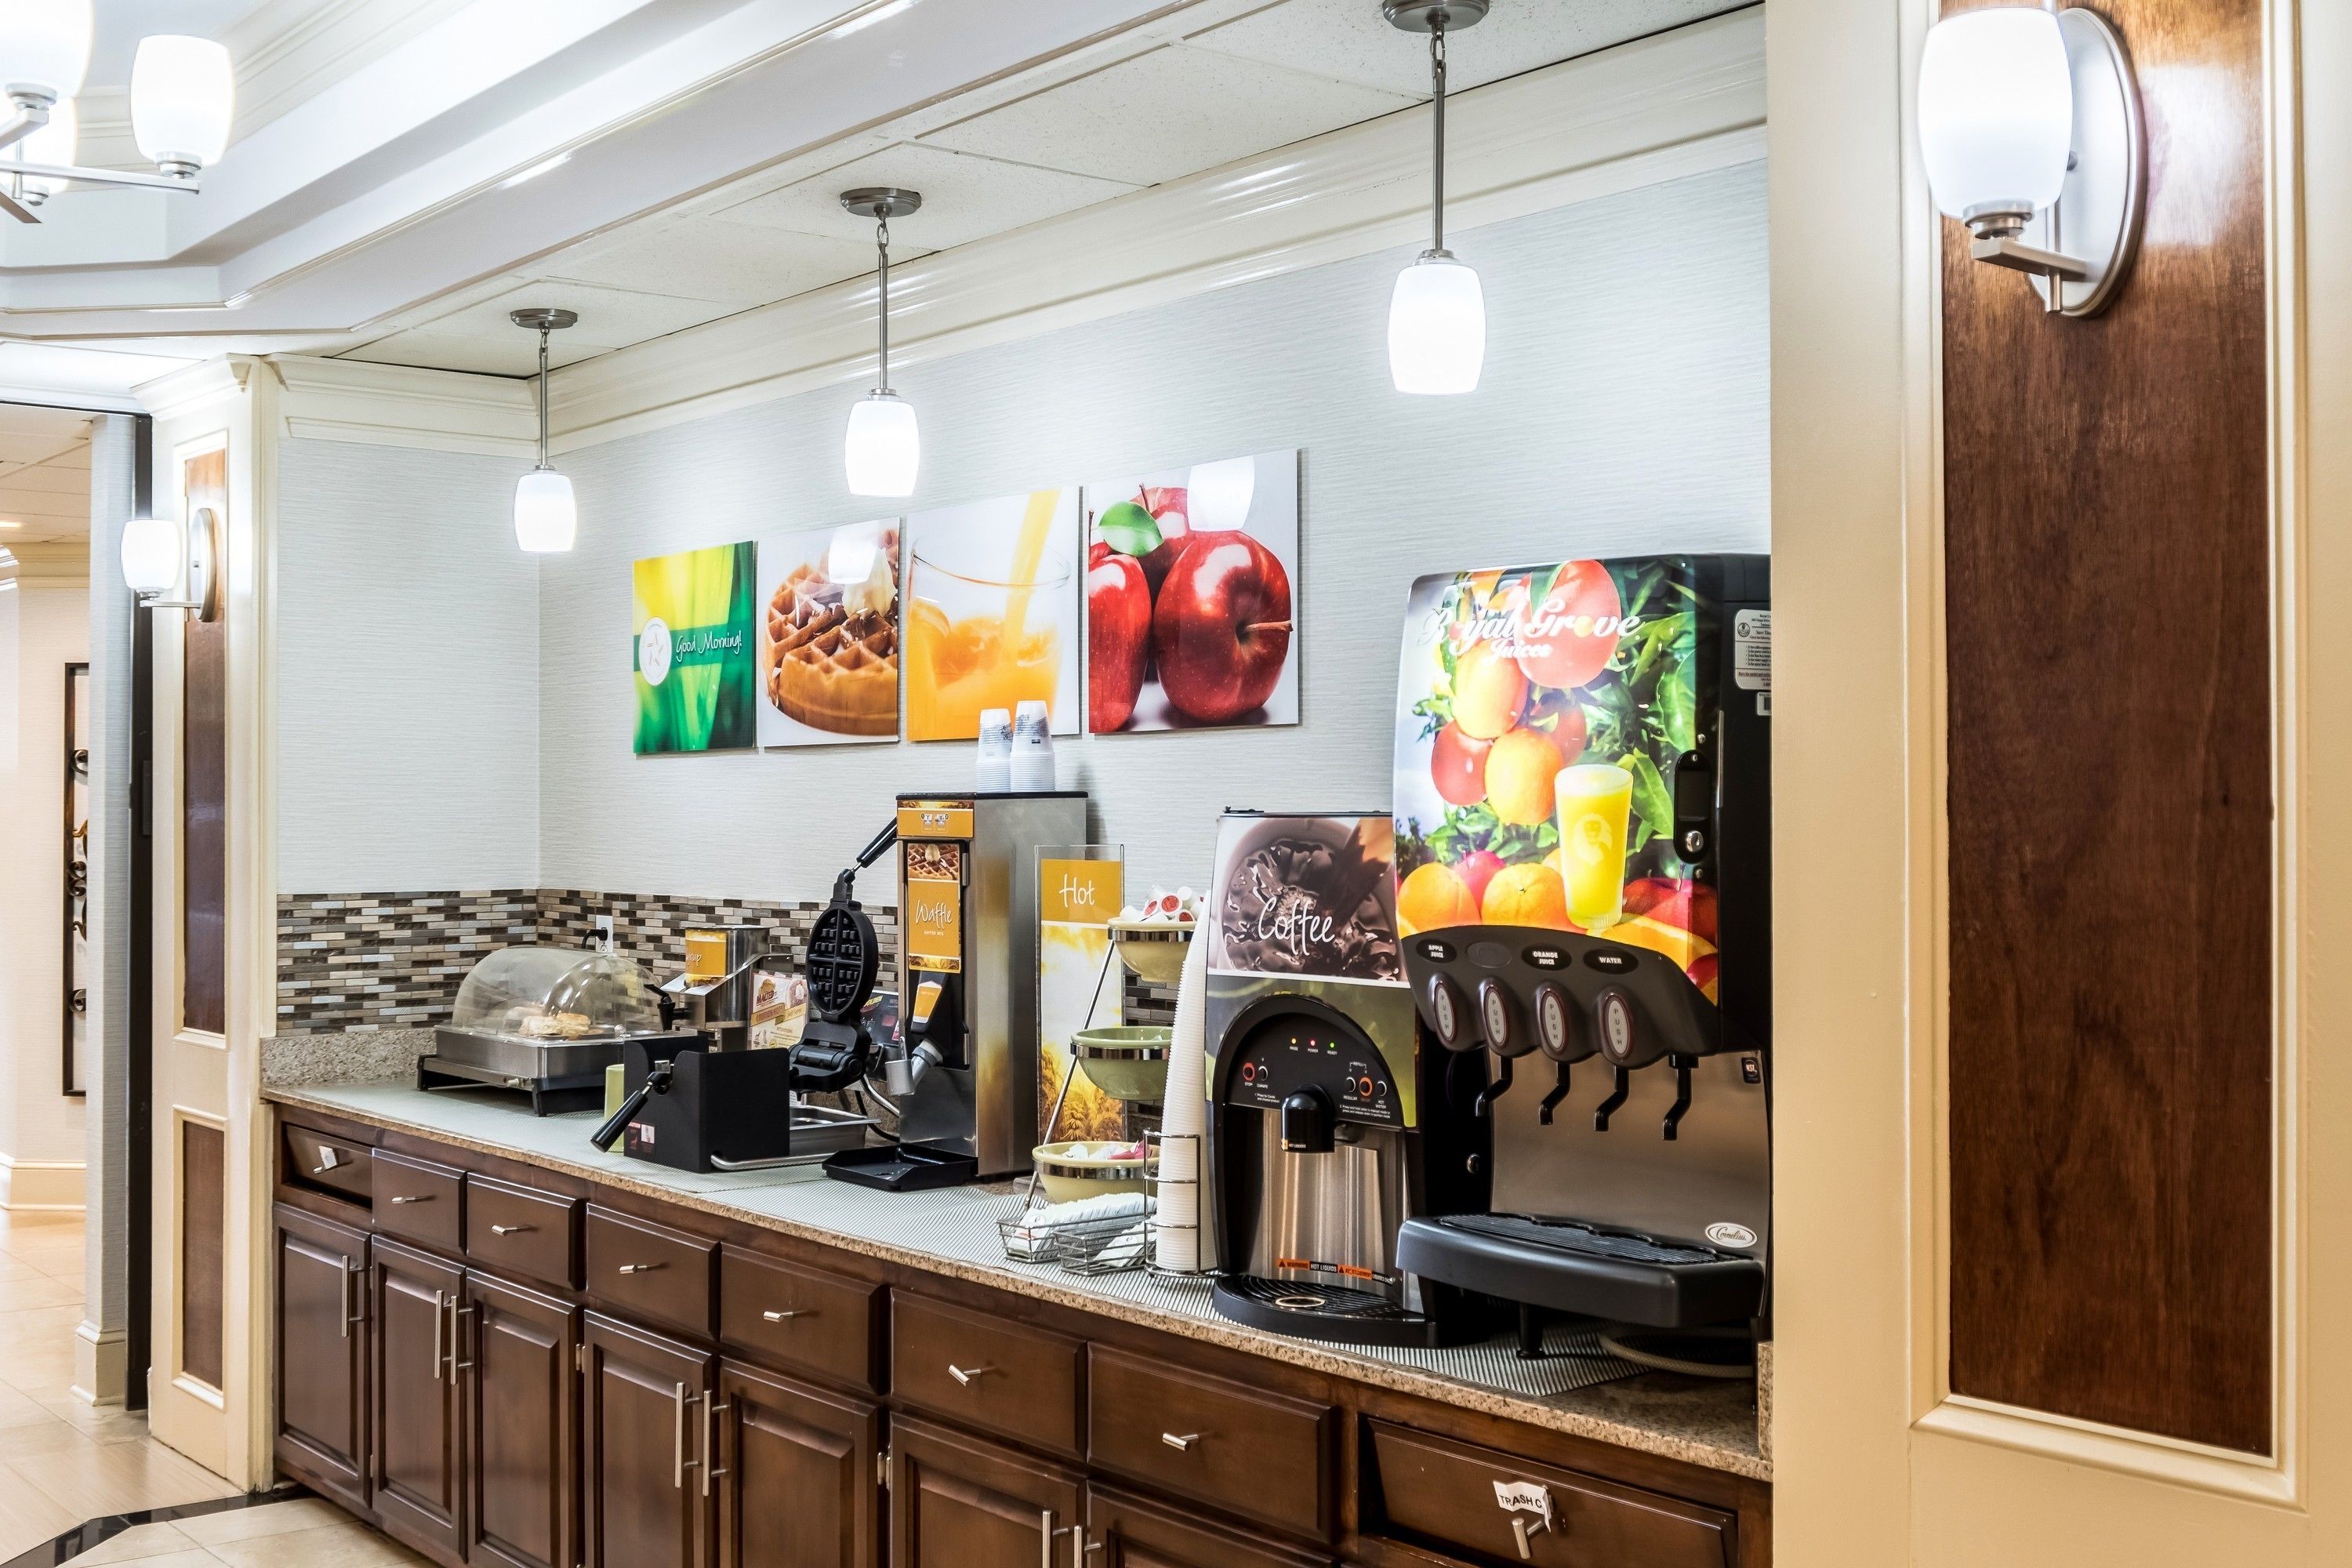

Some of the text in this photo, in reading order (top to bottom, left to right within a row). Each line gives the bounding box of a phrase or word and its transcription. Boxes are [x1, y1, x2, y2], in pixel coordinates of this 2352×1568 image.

[1525, 598, 1646, 638] Grove
[676, 630, 742, 662] Good Morning!
[1490, 637, 1554, 663] Juices
[1058, 873, 1096, 909] Hot
[915, 899, 953, 930] Waffle
[1258, 897, 1336, 956] Coffee
[1492, 1000, 1501, 1035] PUSH
[1549, 1004, 1559, 1040] PUSH
[1614, 1007, 1623, 1045] PUSH
[1716, 1226, 1746, 1241] Cornelius
[1499, 1494, 1534, 1507] TRASH
